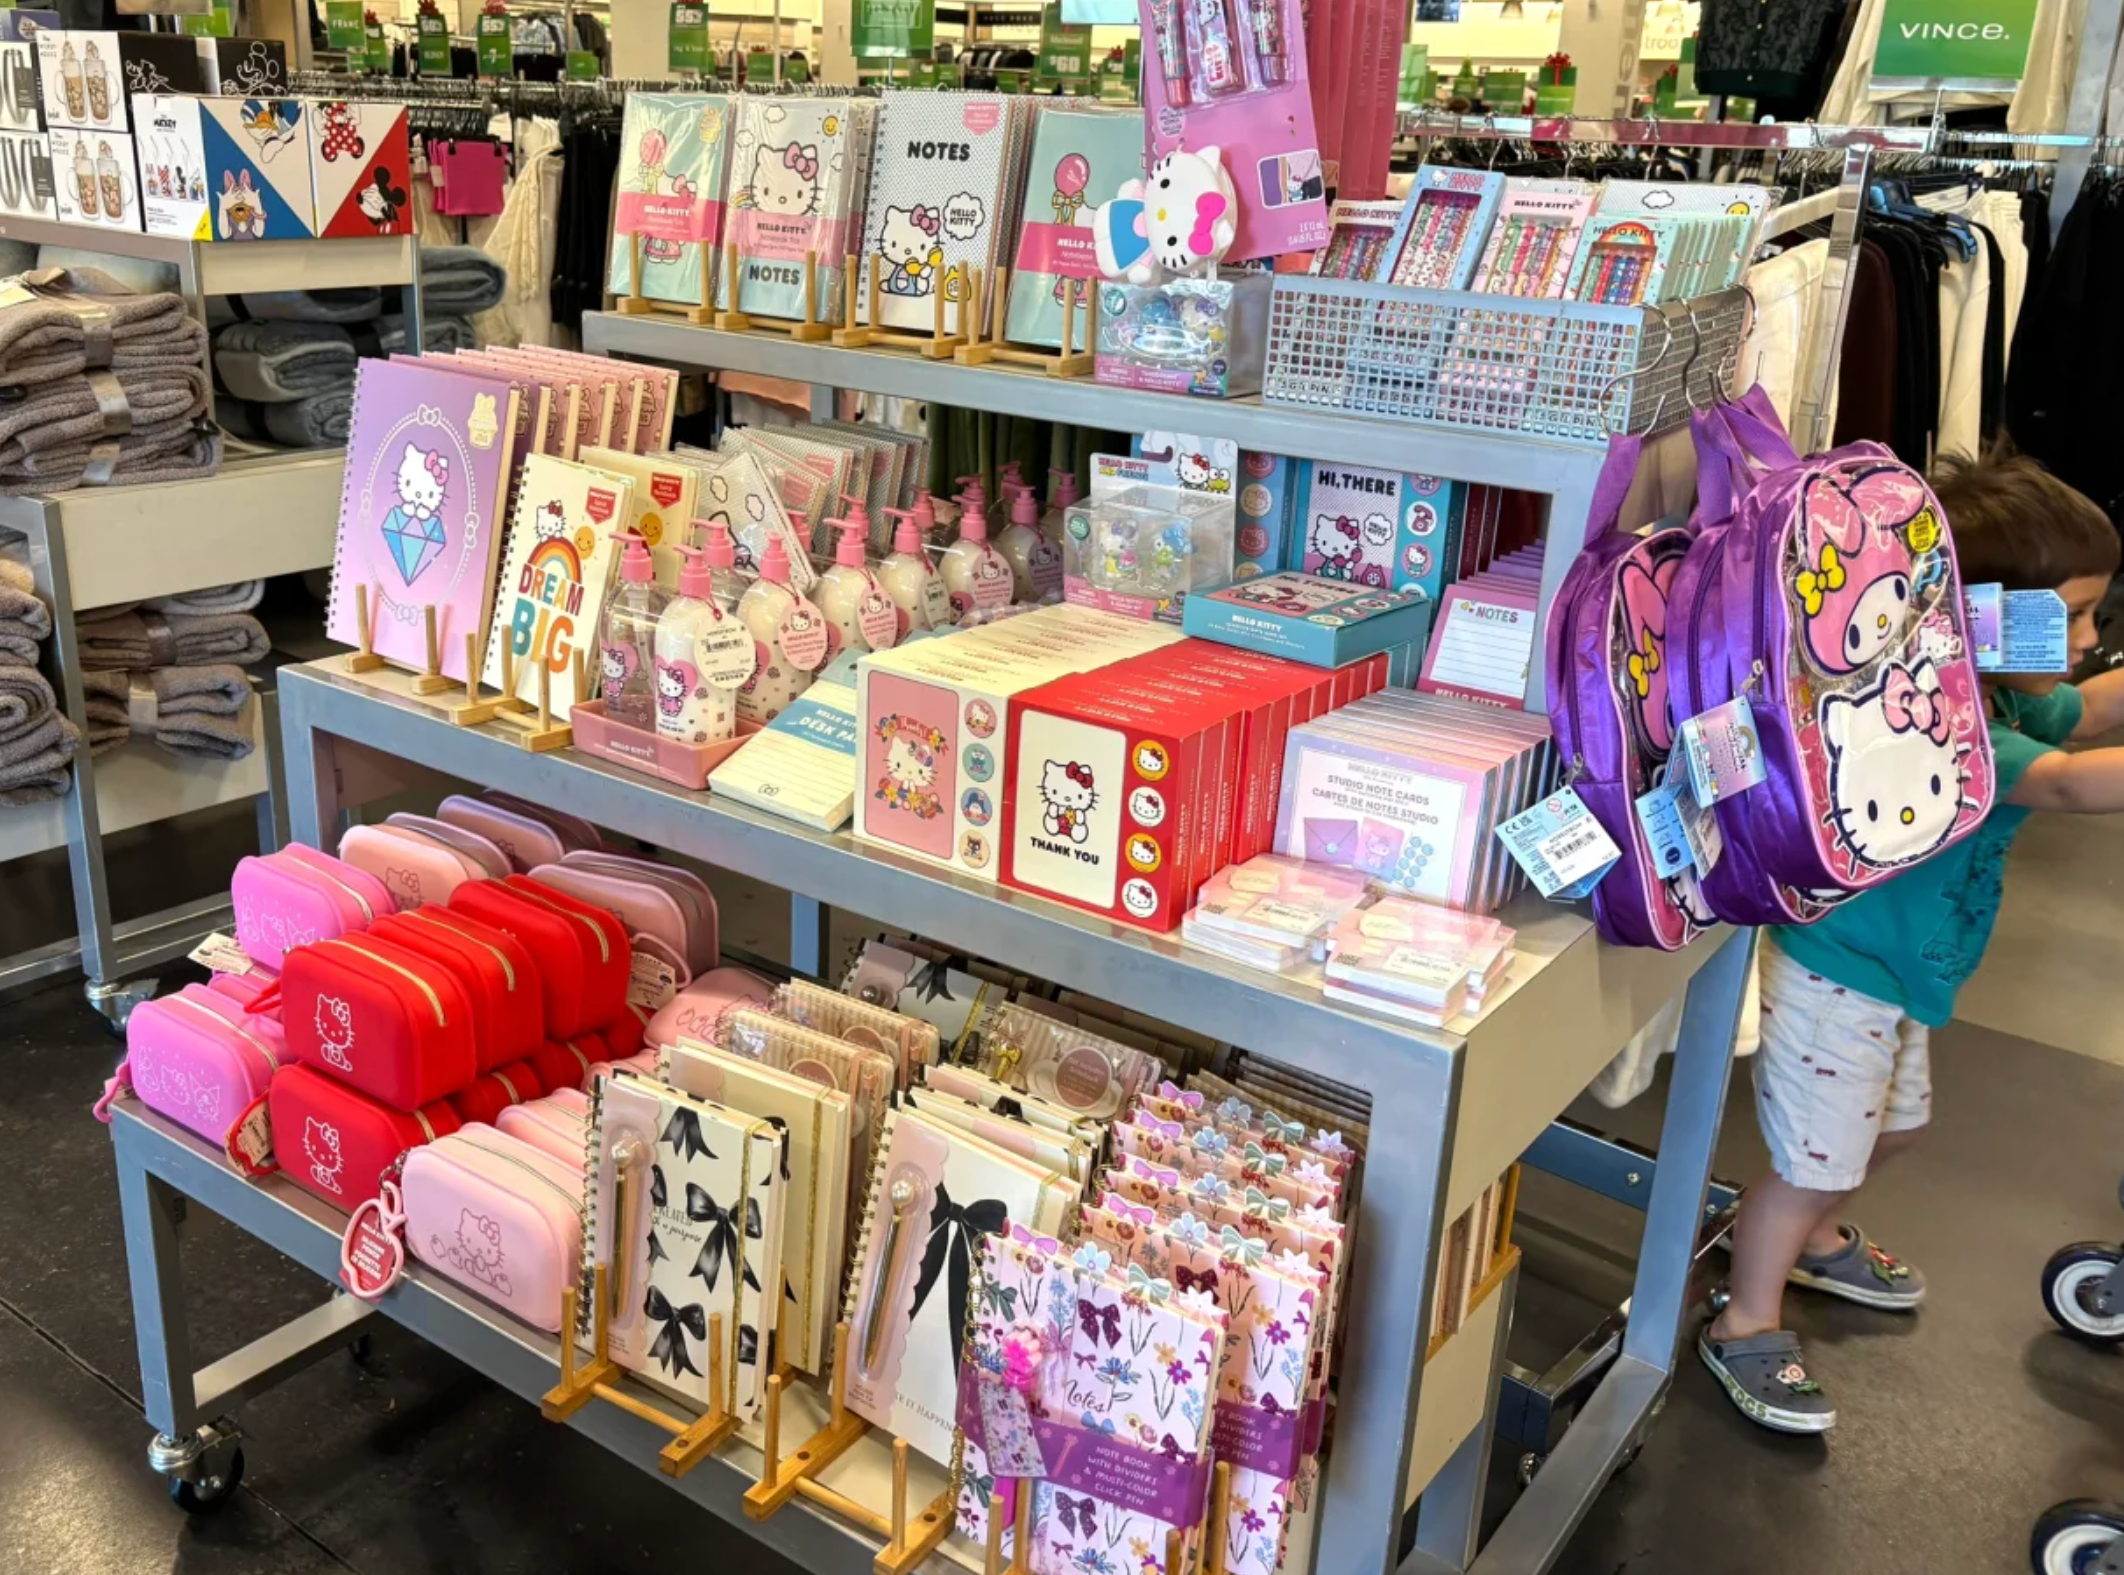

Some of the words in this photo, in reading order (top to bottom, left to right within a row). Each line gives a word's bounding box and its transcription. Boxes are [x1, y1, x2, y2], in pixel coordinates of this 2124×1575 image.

[907, 141, 970, 161] NOTES
[1451, 172, 1485, 183] HELLO
[949, 208, 977, 217] HELLO
[1336, 207, 1369, 217] HELLO
[1514, 200, 1543, 208] HELLO
[1544, 202, 1575, 210] KITTY
[757, 222, 780, 232] HELLO
[781, 225, 807, 235] KITTY
[949, 217, 976, 226] KITTY
[1594, 226, 1628, 236] HELLO
[1630, 228, 1665, 238] KITTY
[1057, 238, 1085, 249] HELLO
[748, 264, 800, 285] NOTES
[1342, 473, 1396, 496] THERE
[518, 563, 584, 616] DREAM
[1475, 606, 1519, 623] NOTES
[1232, 615, 1256, 626] HELLO
[1257, 621, 1283, 632] KITTY
[511, 597, 574, 673] BIG
[1435, 688, 1470, 701] HELLO
[815, 709, 841, 724] HELLO
[799, 716, 835, 736] DESK
[836, 730, 857, 743] PA
[1348, 762, 1380, 778] HELLO
[1327, 774, 1364, 790] STUDIO
[1365, 783, 1394, 797] NOTE
[1395, 790, 1430, 806] CARDS
[1312, 787, 1349, 803] CARTES
[1350, 796, 1363, 807] DE
[1365, 800, 1398, 815] NOTES
[1400, 808, 1439, 825] STUDIO
[1030, 836, 1071, 858] THANK
[1074, 849, 1100, 865] YOU
[1228, 1411, 1256, 1426] BOOK
[1220, 1420, 1262, 1440] DIVIDERS
[1095, 1446, 1119, 1460] NOTE
[1123, 1455, 1151, 1470] BOOK
[1231, 1449, 1249, 1461] PEN
[1087, 1455, 1112, 1469] WITH
[1114, 1464, 1158, 1486] DIVIDERS
[1083, 1466, 1091, 1475] &
[1095, 1470, 1158, 1498] MULTI-COLOR
[1094, 1483, 1123, 1498] CLICK
[1125, 1493, 1144, 1505] PEN
